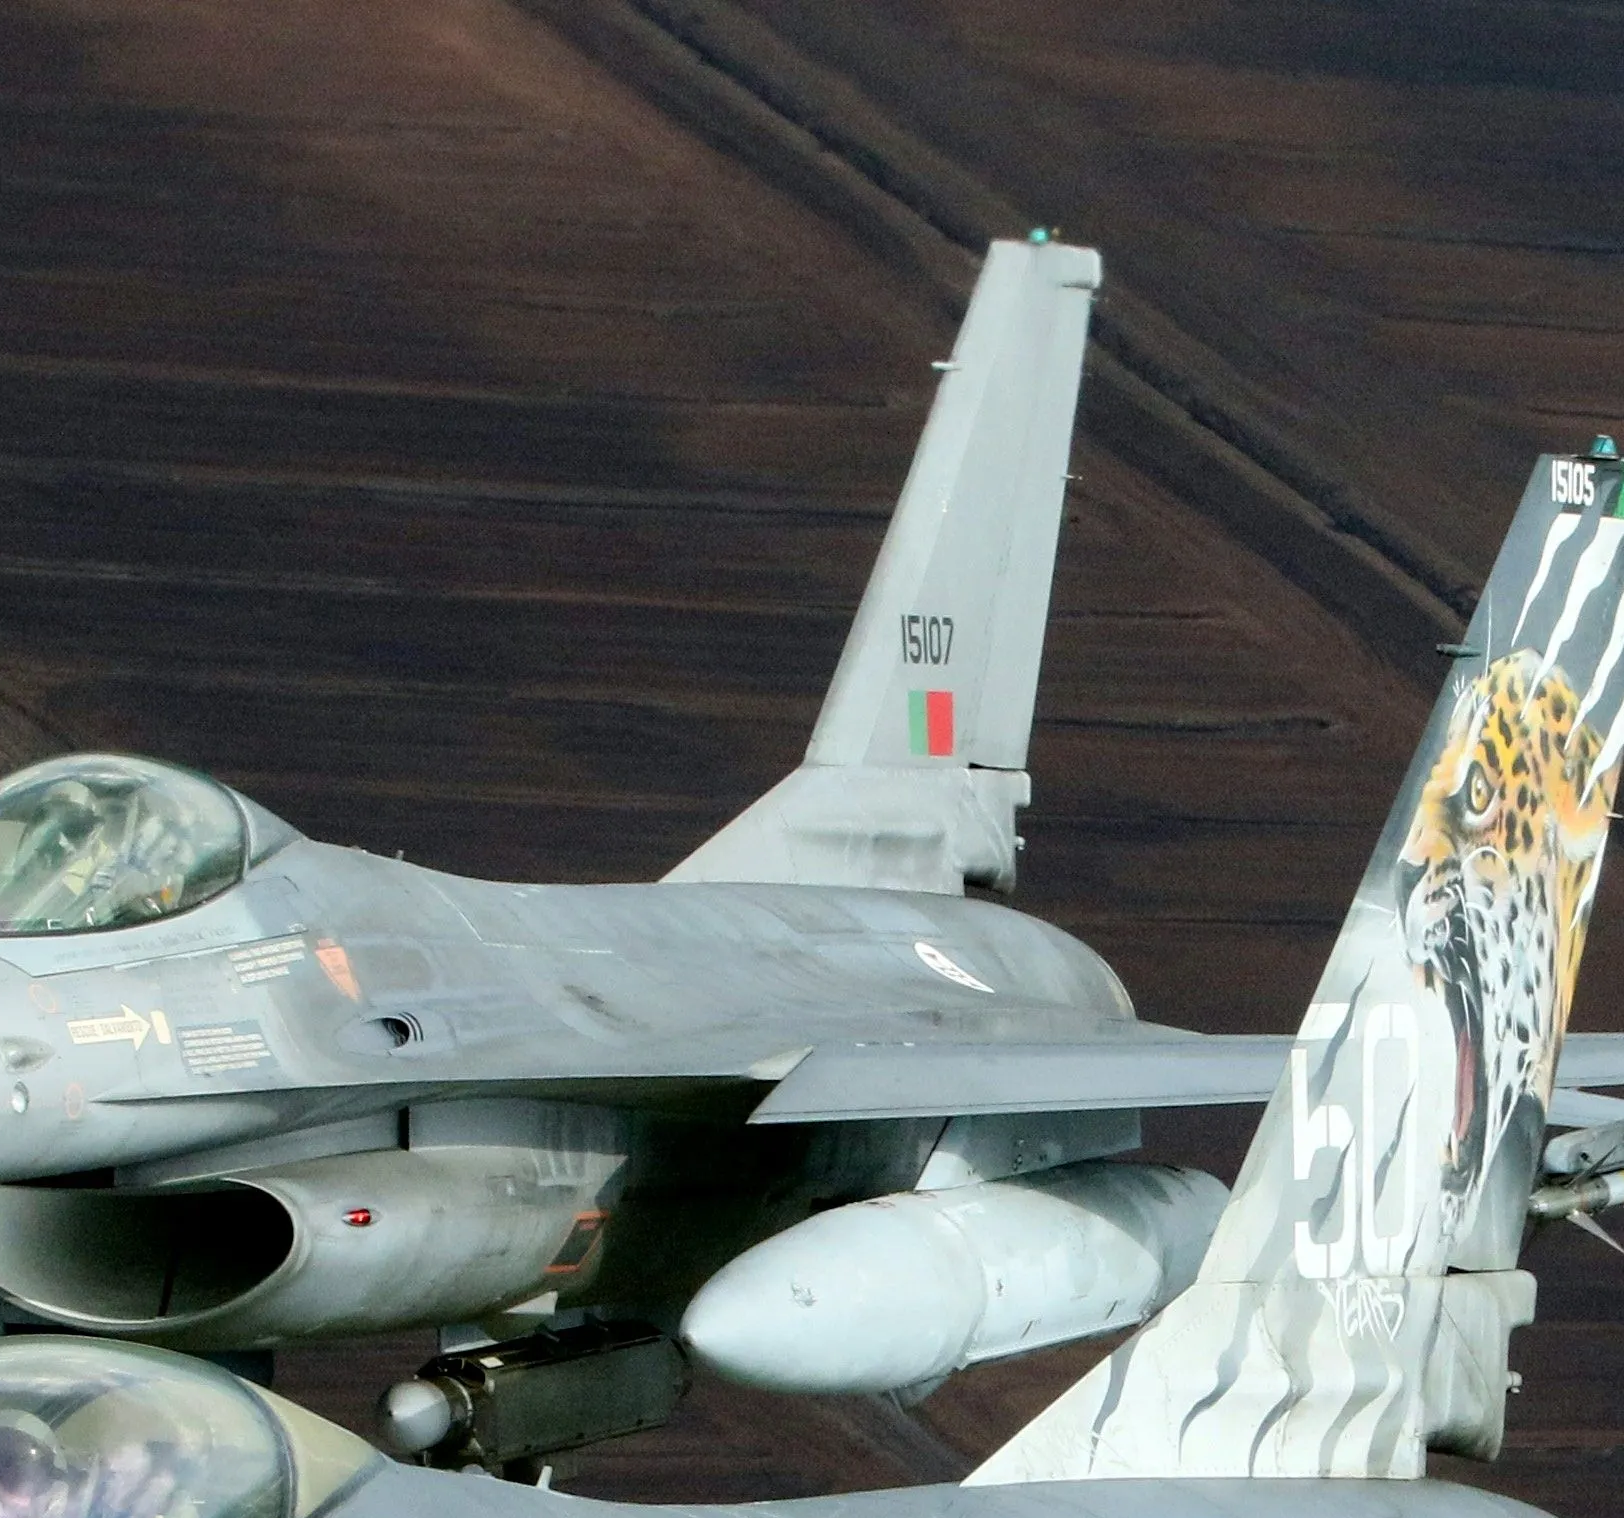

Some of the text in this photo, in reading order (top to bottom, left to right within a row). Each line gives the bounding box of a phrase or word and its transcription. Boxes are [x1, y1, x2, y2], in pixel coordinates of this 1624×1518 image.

[1552, 461, 1595, 505] 15105
[902, 615, 954, 665] 15107
[1290, 1002, 1420, 1280] 50
